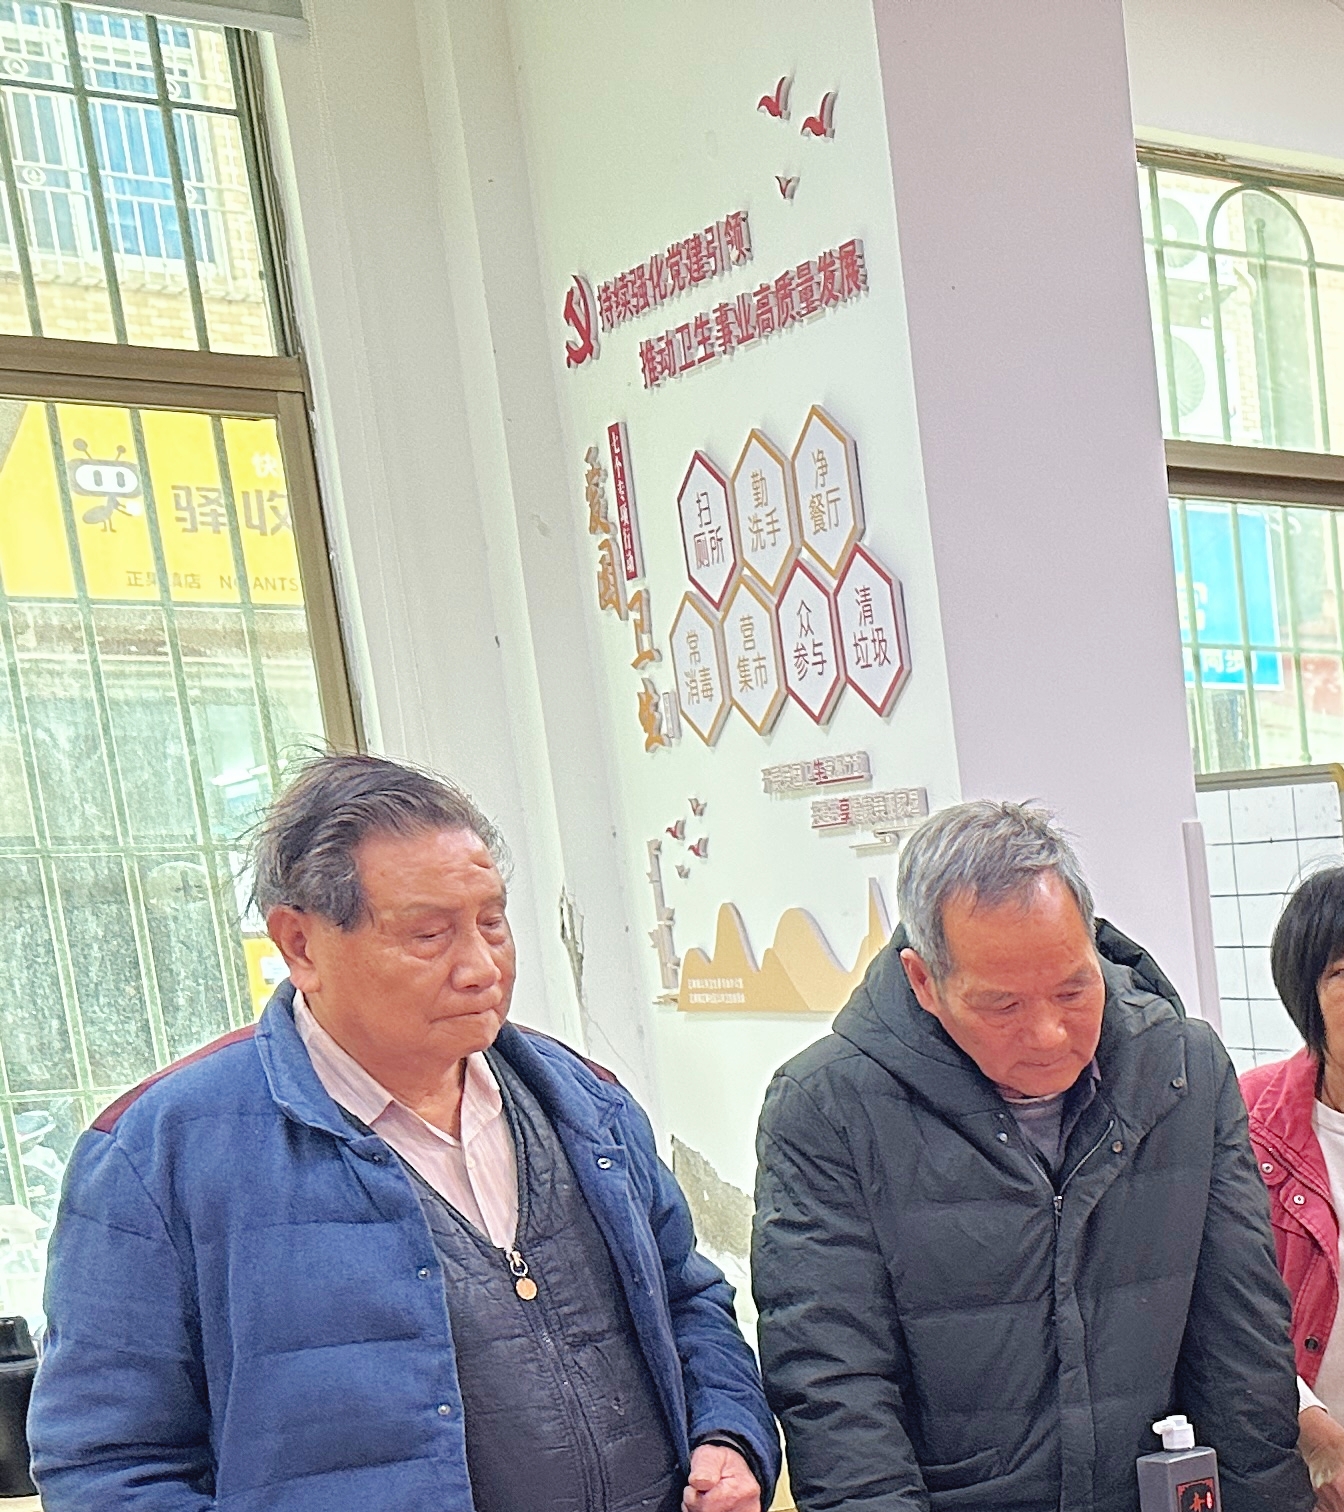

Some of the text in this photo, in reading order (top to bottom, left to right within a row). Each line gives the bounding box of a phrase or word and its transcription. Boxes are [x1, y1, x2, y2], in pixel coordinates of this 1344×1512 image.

[597, 211, 751, 331] 持续强化党建引领
[640, 239, 867, 388] 推动卫生事业高质量发展
[793, 638, 827, 681] 参与
[853, 627, 891, 669] 垃圾
